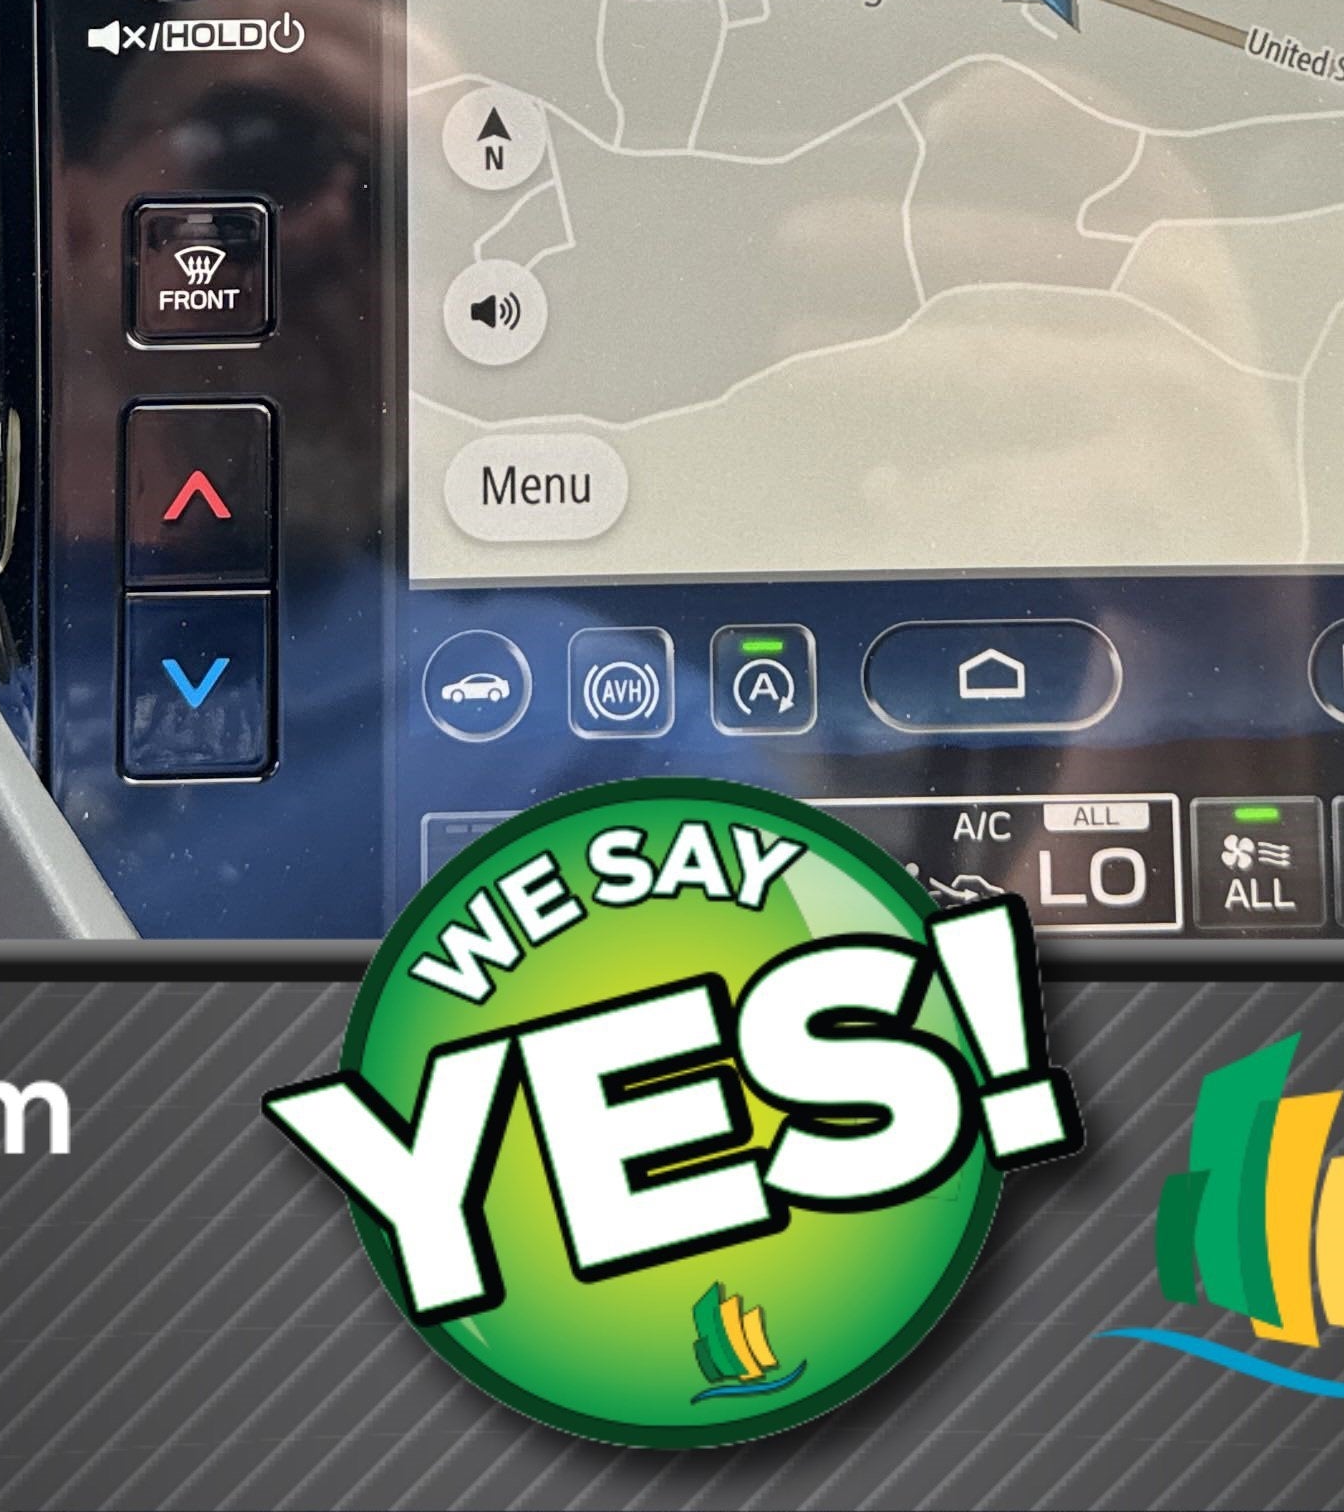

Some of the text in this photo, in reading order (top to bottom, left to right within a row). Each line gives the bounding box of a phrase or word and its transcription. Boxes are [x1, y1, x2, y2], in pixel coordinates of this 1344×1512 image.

[1247, 30, 1335, 78] United
[485, 145, 505, 170] N
[159, 289, 240, 311] FRONT
[482, 465, 591, 505] Menu
[602, 677, 642, 704] AVH
[953, 811, 1012, 842] A/C
[1072, 806, 1121, 827] ALL
[1038, 848, 1148, 906] LO
[1223, 877, 1297, 911] ALL
